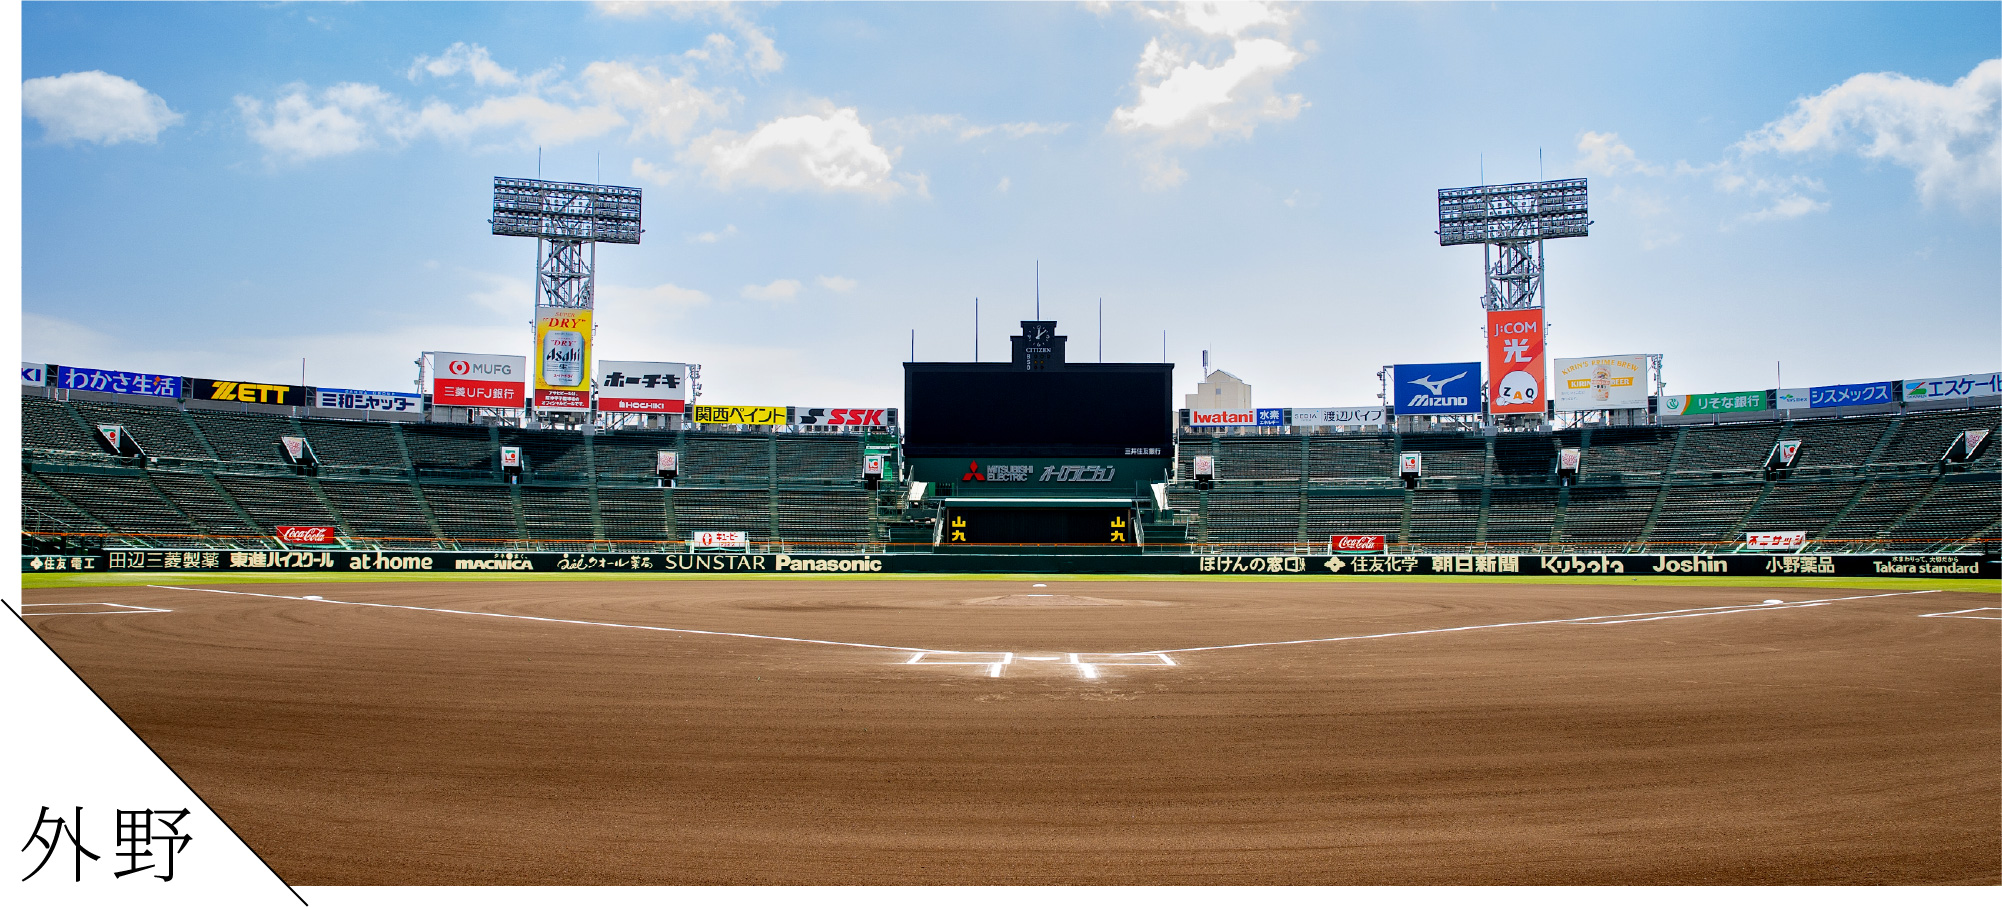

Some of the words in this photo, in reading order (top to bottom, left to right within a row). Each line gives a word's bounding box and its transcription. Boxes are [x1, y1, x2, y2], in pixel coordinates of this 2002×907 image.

[1493, 321, 1537, 337] J:COM
[546, 347, 581, 362] Asahi
[1503, 338, 1533, 364] 光
[472, 363, 512, 375] MUFG
[1561, 360, 1589, 376] KIRIN'S
[1616, 360, 1639, 372] BREW
[65, 368, 176, 396] わかさ生活
[603, 371, 681, 389] ホーチキ
[210, 381, 290, 404] ZETT
[444, 386, 515, 400] 三菱UFJ銀行
[1812, 385, 1889, 404] シスメックス
[321, 392, 415, 411] 三和シャッター
[625, 401, 665, 410] HOCHIKI
[1698, 394, 1760, 410] りそな銀行
[695, 406, 785, 423] 関西ペイント
[827, 408, 885, 426] SSK
[1193, 410, 1254, 424] Iwatani
[1259, 409, 1280, 420] 水素
[1323, 408, 1386, 422] 渡辺パイプ
[987, 465, 1034, 474] MITSUBISHI
[987, 473, 1028, 482] ELECTRIC
[283, 527, 327, 542] Coca-Cola
[951, 515, 967, 542] 山九
[1110, 516, 1126, 542] 山九
[1338, 535, 1378, 549] Coca-Cola
[109, 551, 220, 569] 田辺三菱製薬
[229, 551, 334, 568] 東進ハイスクール
[664, 554, 766, 571] SUNSTAR
[775, 555, 883, 572] Panasonic
[1199, 556, 1301, 573] ほけんの窓口
[1350, 556, 1419, 573] 住友化学
[1431, 556, 1520, 573] 朝日新聞
[1540, 556, 1625, 574] Kubota
[1652, 555, 1728, 573] Joshin
[1765, 556, 1836, 574] 小野薬品
[1872, 560, 1917, 574] Takara
[1918, 561, 1980, 574] standard
